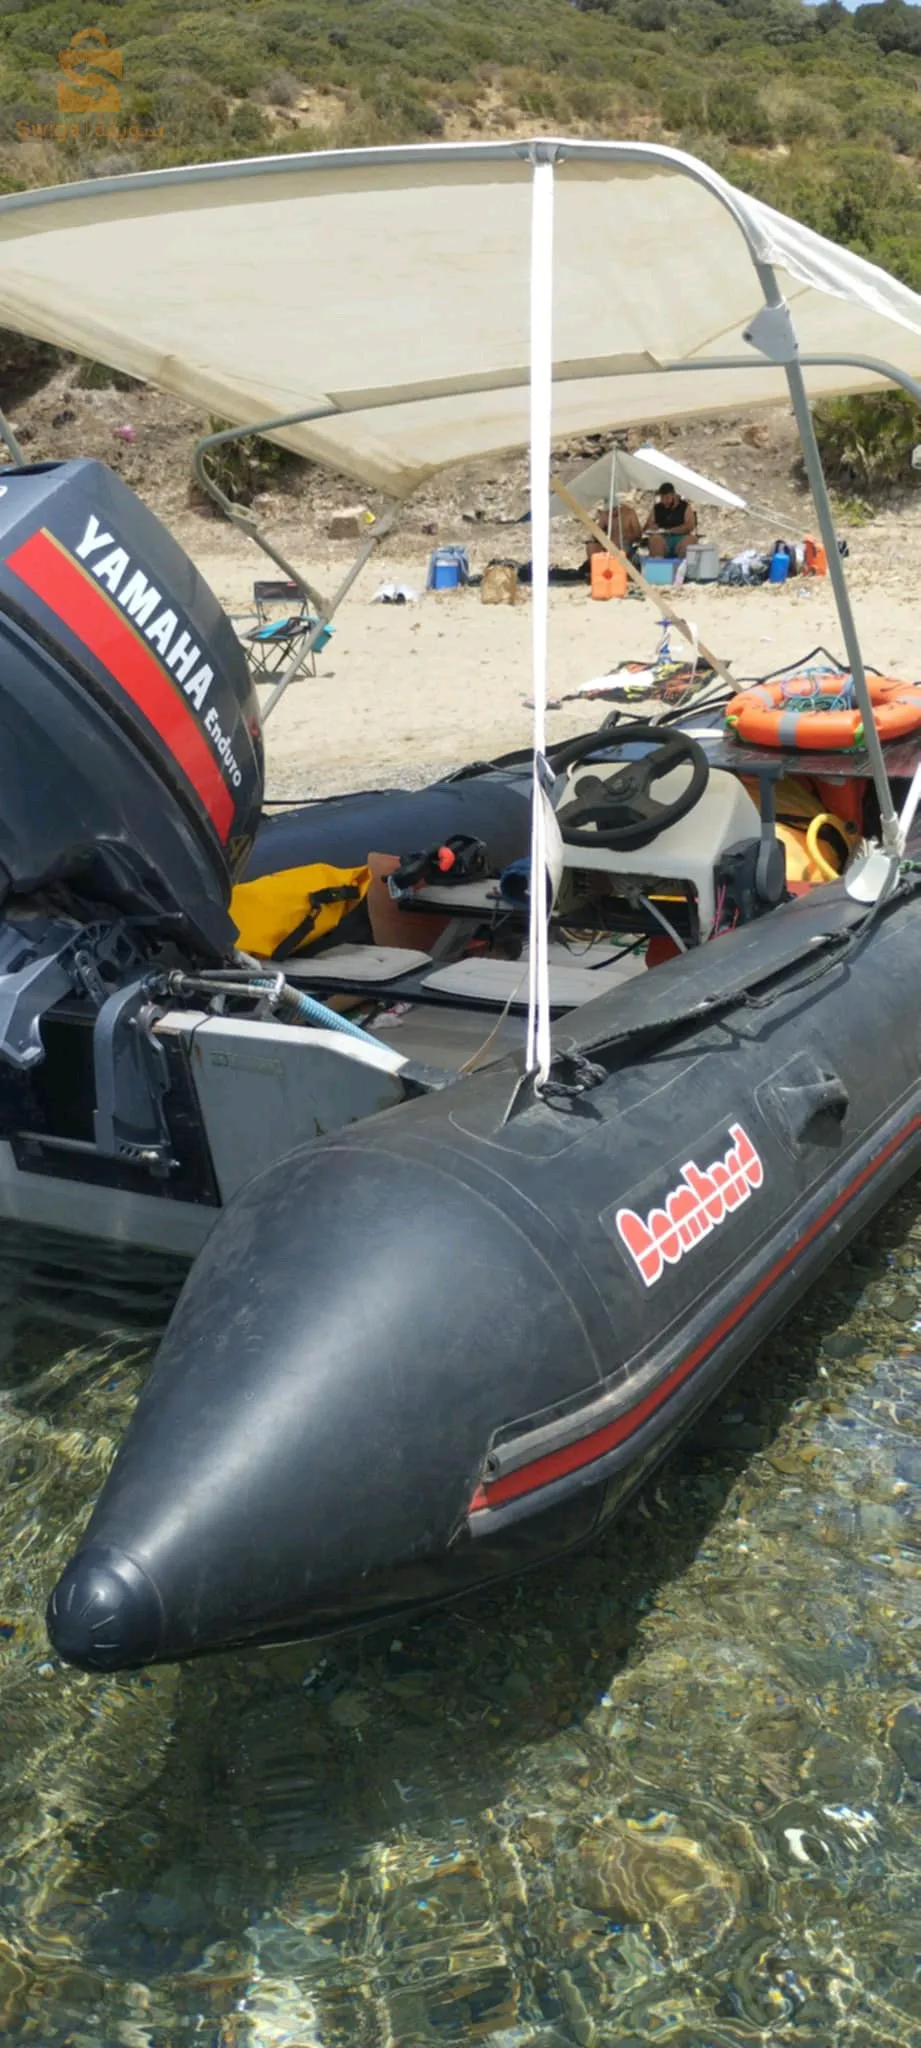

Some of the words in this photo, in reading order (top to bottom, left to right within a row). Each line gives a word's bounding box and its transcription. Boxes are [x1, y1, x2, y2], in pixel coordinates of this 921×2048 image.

[75, 514, 215, 711] YAMAHA
[203, 707, 242, 787] Enduro
[616, 1122, 763, 1287] Bombard
